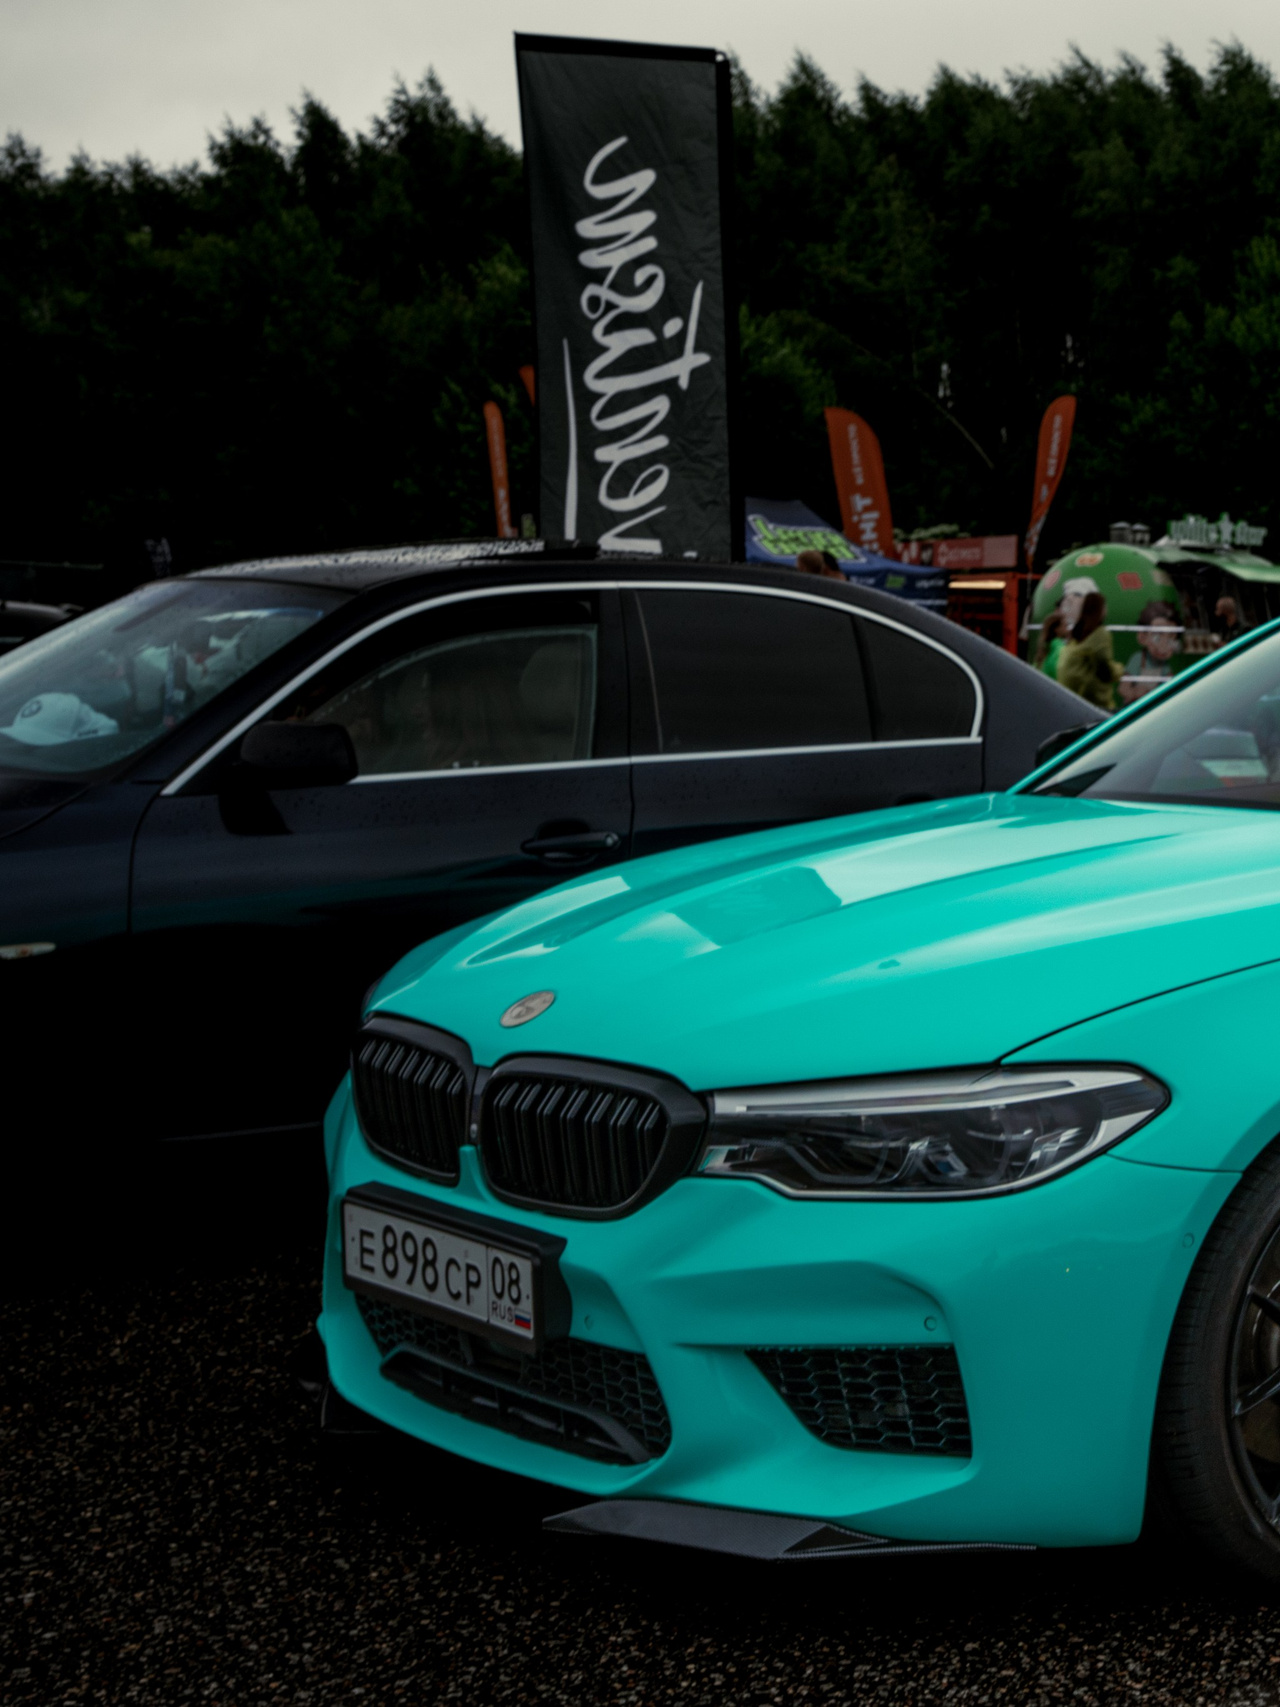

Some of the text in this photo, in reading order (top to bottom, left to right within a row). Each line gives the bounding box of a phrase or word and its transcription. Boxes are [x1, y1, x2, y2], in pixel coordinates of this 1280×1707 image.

[359, 1224, 522, 1306] E898CP 08
[491, 1300, 514, 1323] RUS
